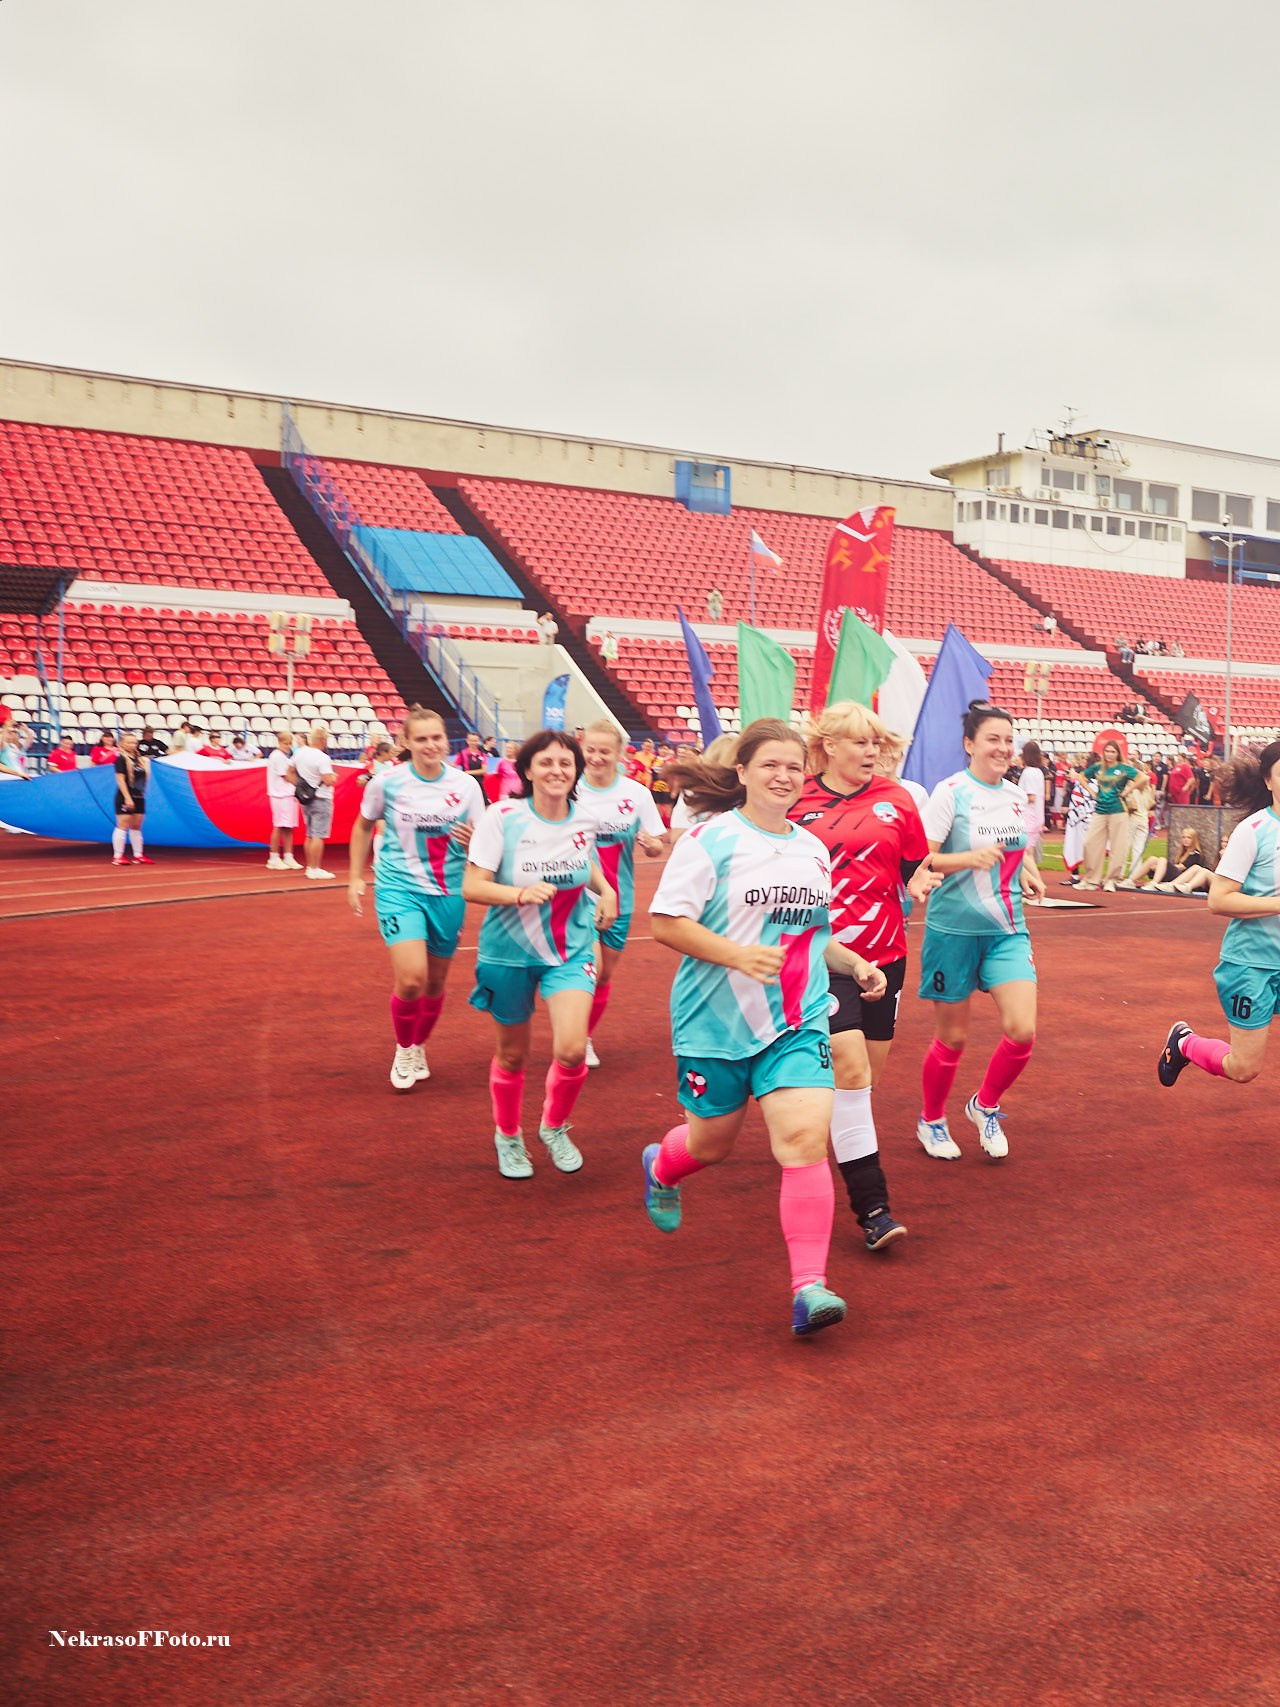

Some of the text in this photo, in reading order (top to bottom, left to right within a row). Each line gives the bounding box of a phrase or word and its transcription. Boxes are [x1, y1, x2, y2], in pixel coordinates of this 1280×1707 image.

[768, 906, 813, 926] МАМА
[933, 971, 945, 993] 8
[1231, 994, 1252, 1019] 16
